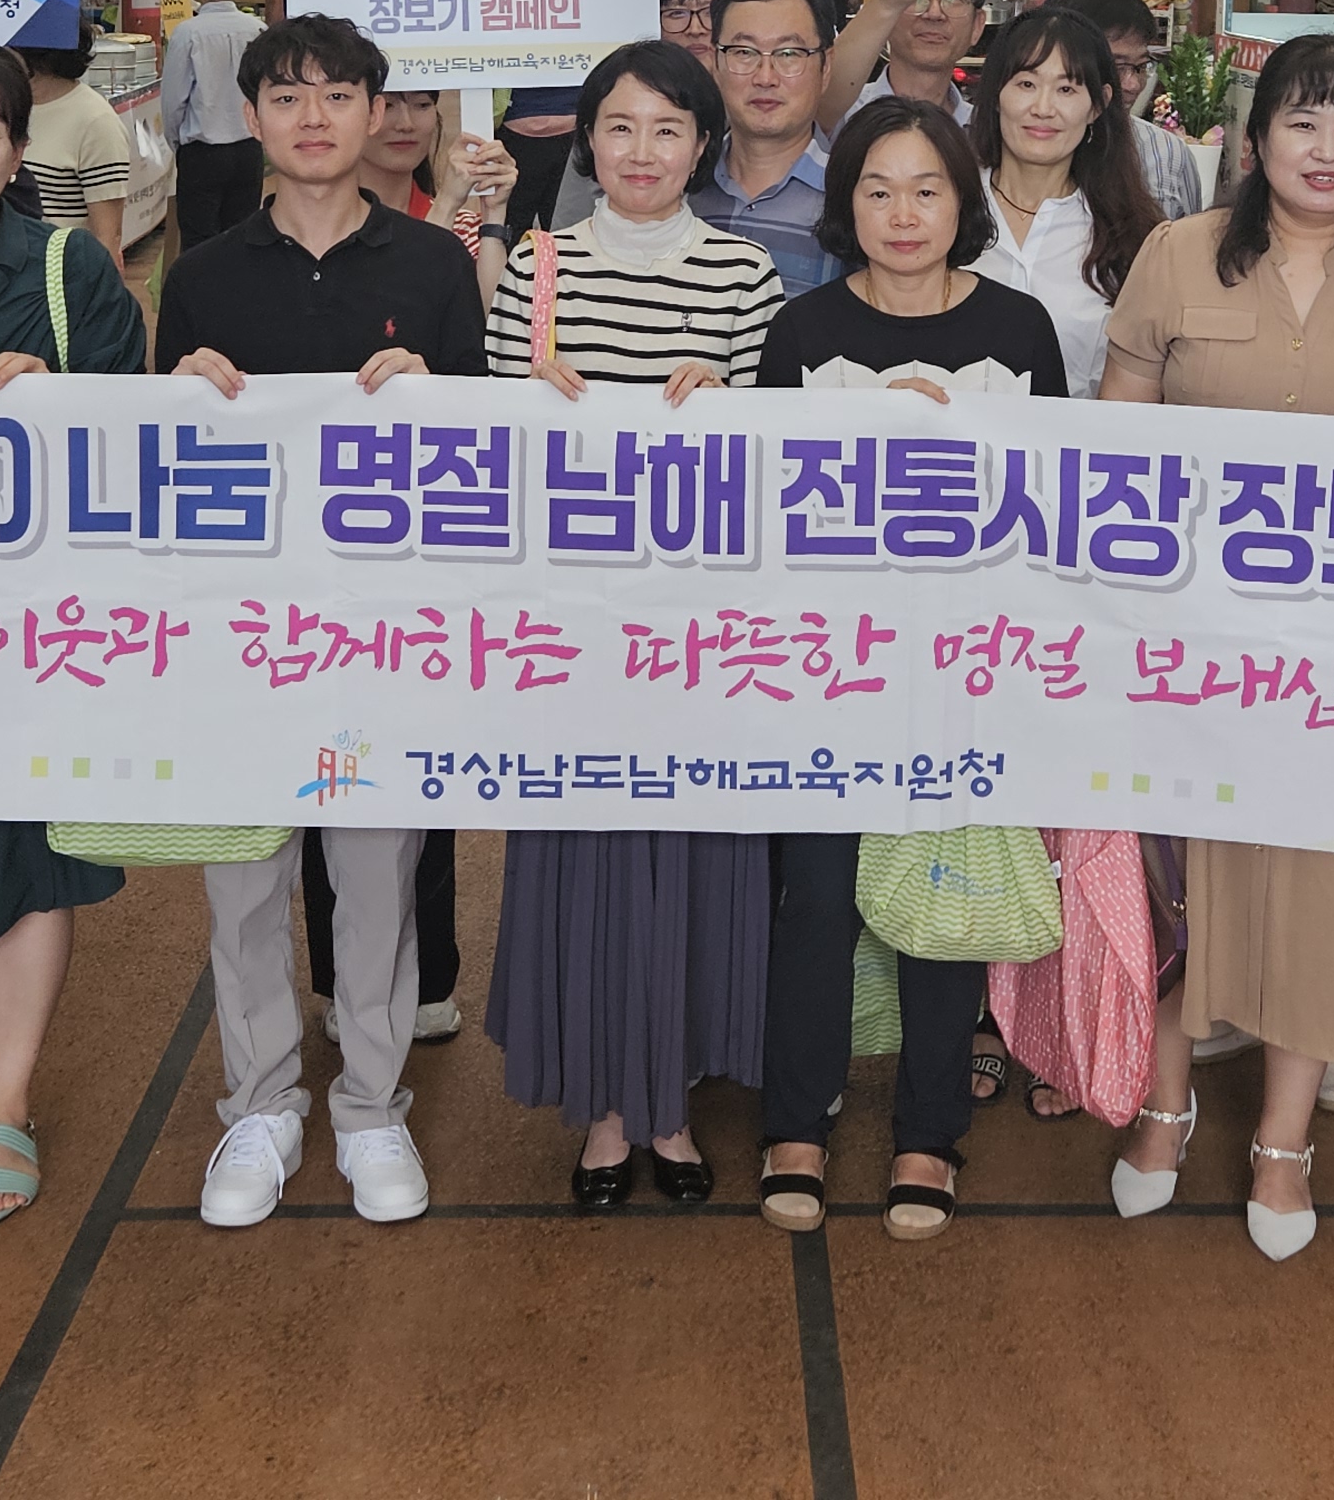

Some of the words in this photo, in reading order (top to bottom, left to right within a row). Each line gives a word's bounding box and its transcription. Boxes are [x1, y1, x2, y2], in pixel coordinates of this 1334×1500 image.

[397, 52, 593, 76] 경상남도남해교육지원청
[68, 423, 272, 545] 나눔
[318, 422, 514, 550] 명절
[544, 429, 749, 560] 남해
[779, 436, 1192, 579] 전통시장
[229, 597, 582, 693] 함께하는
[621, 608, 898, 703] 따뜻한
[932, 613, 1087, 702] 명절
[404, 747, 1007, 802] 경상남도남해교육지원청
